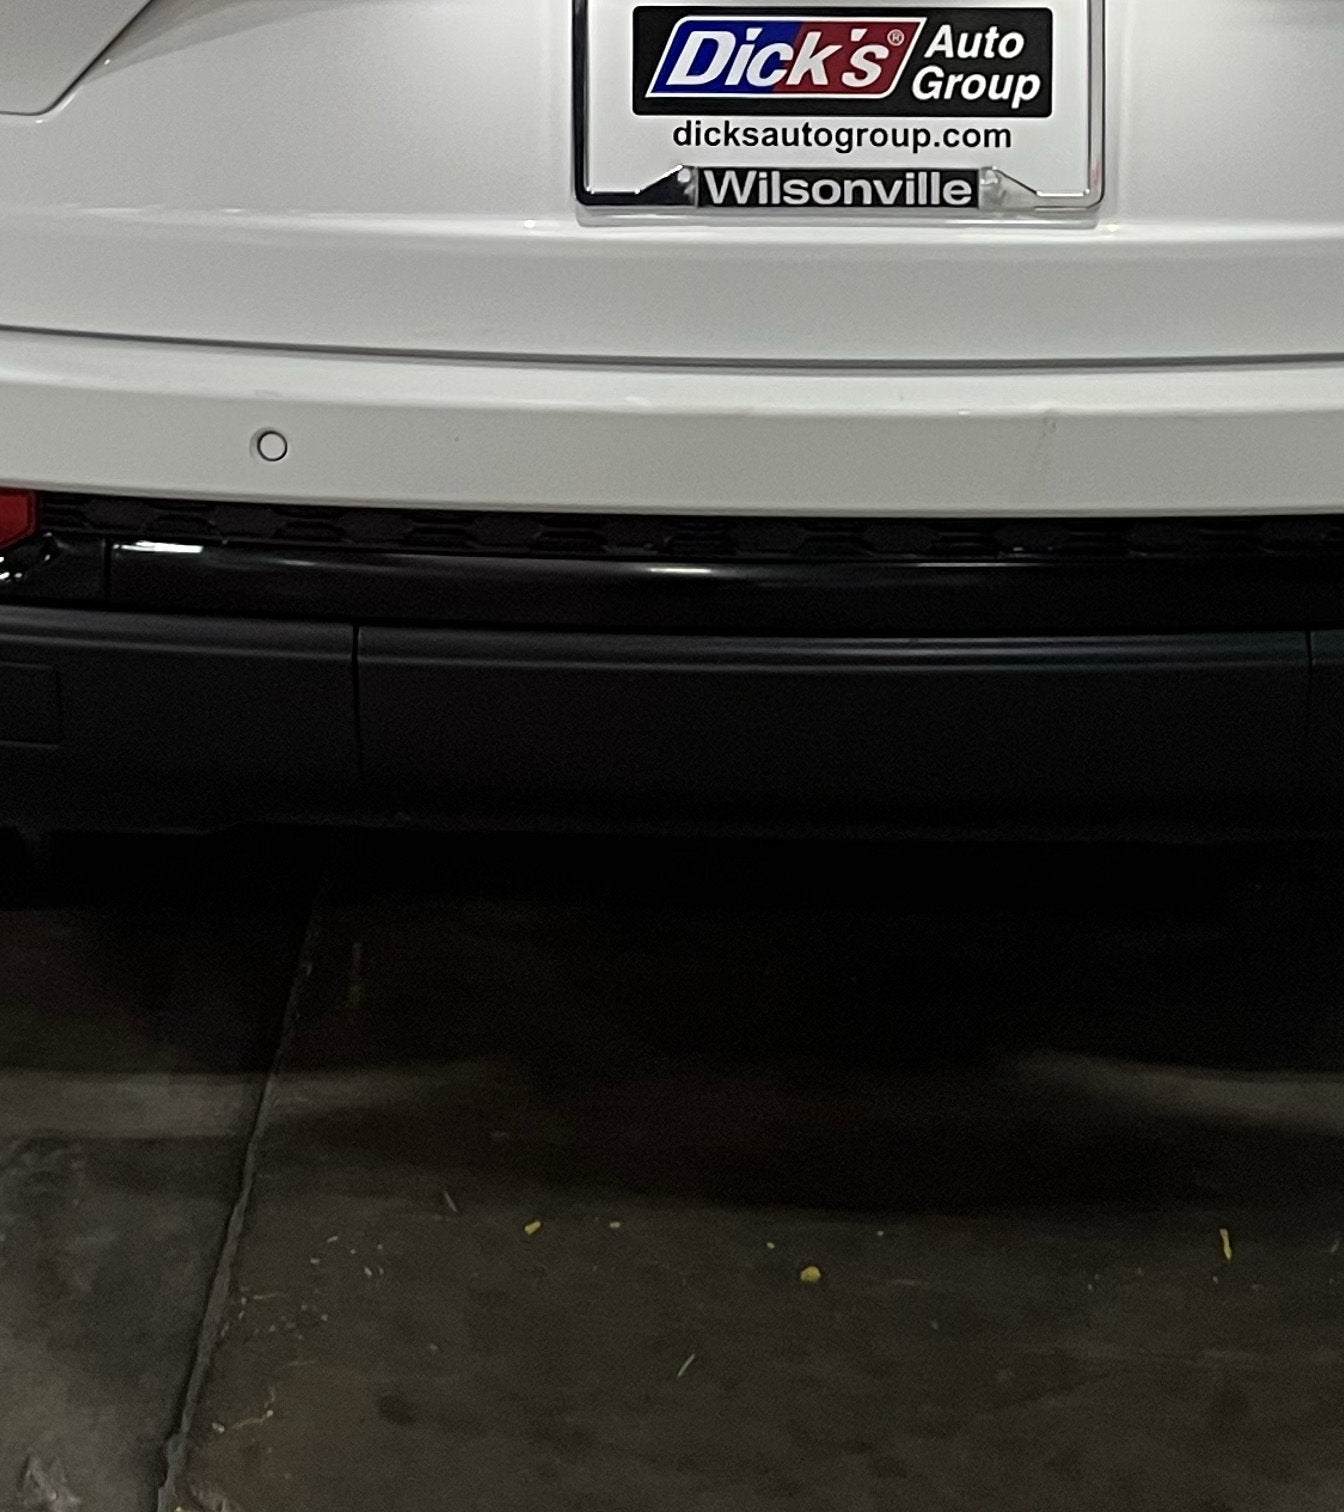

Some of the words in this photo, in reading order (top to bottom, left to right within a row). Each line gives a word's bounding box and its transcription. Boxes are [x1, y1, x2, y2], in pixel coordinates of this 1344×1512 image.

[665, 27, 890, 88] Dick's
[923, 24, 1025, 59] Auto
[911, 66, 1041, 109] Group
[672, 120, 1012, 154] dicksautogroup.com
[703, 169, 973, 206] Wilsonville
